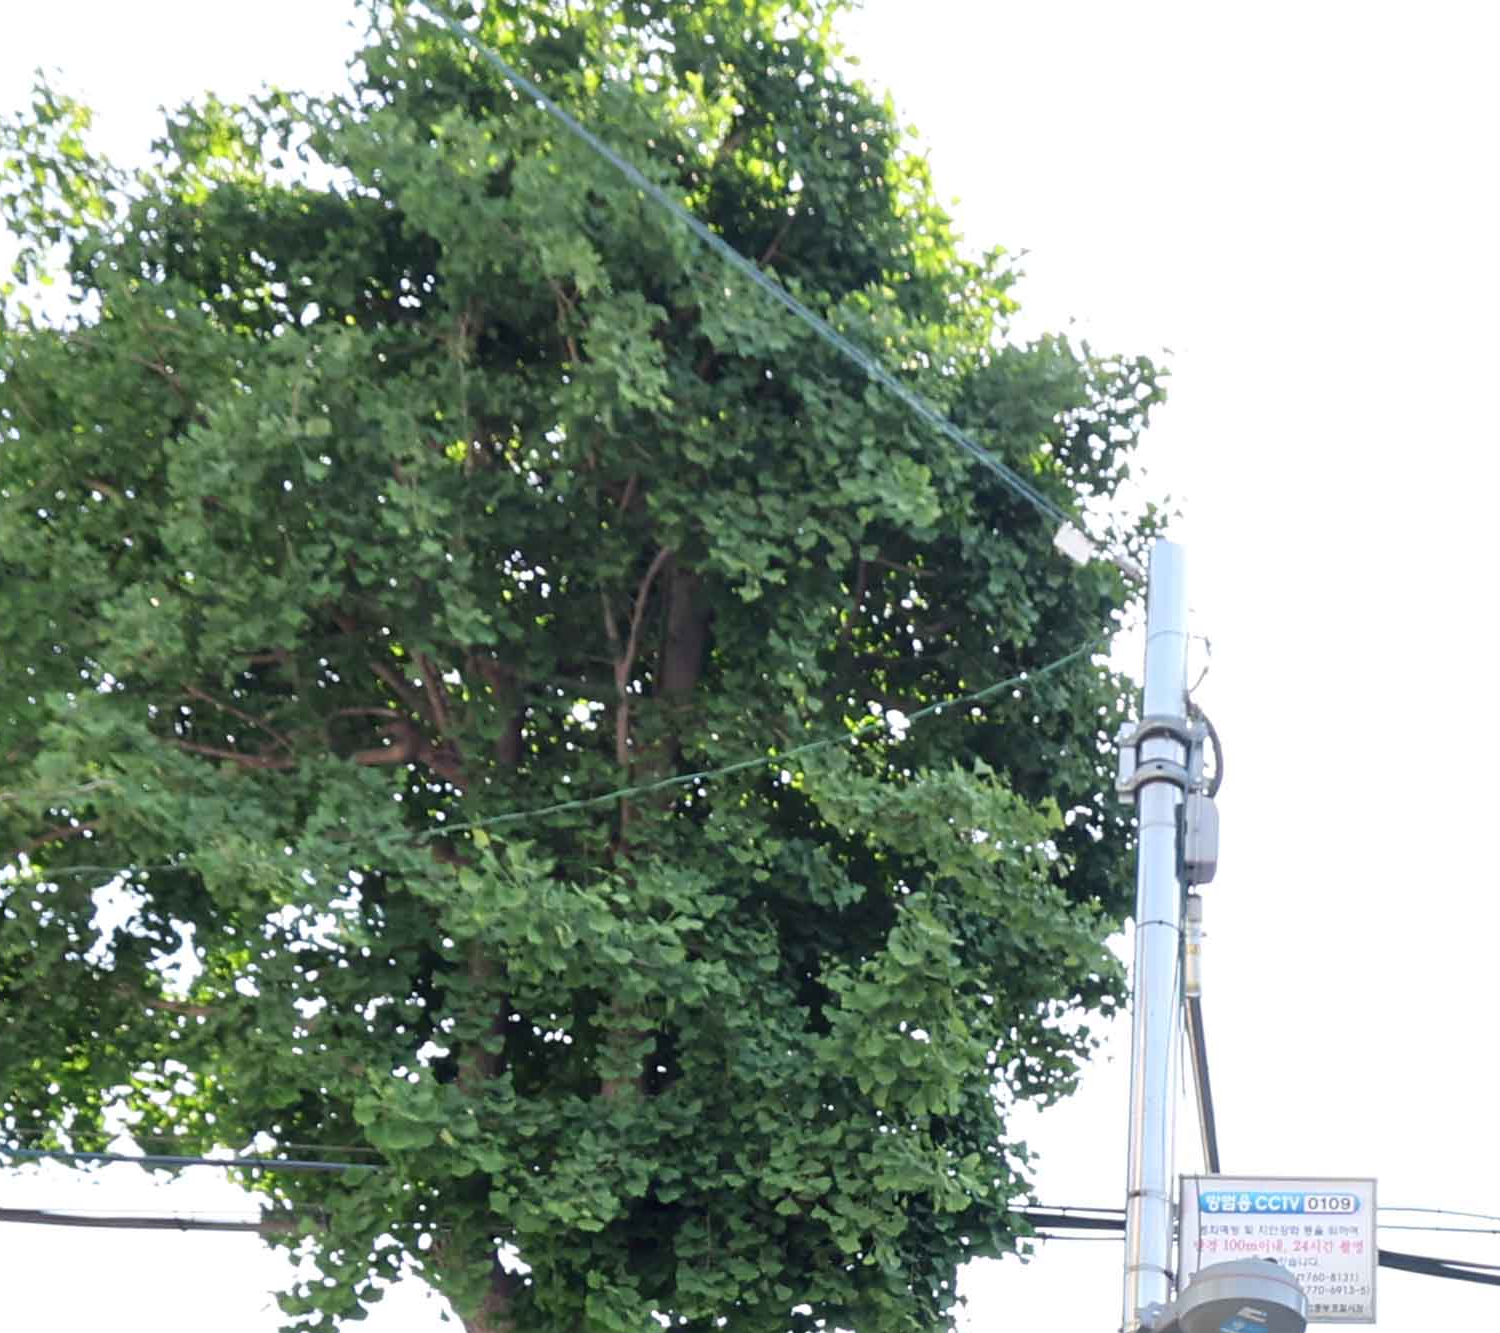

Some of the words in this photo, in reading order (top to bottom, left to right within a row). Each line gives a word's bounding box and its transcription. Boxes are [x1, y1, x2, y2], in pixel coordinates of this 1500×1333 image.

[1206, 1195, 1252, 1212] 방범용
[1255, 1196, 1300, 1211] CCTV
[1308, 1197, 1351, 1210] 0109
[1292, 1240, 1333, 1253] 24시간
